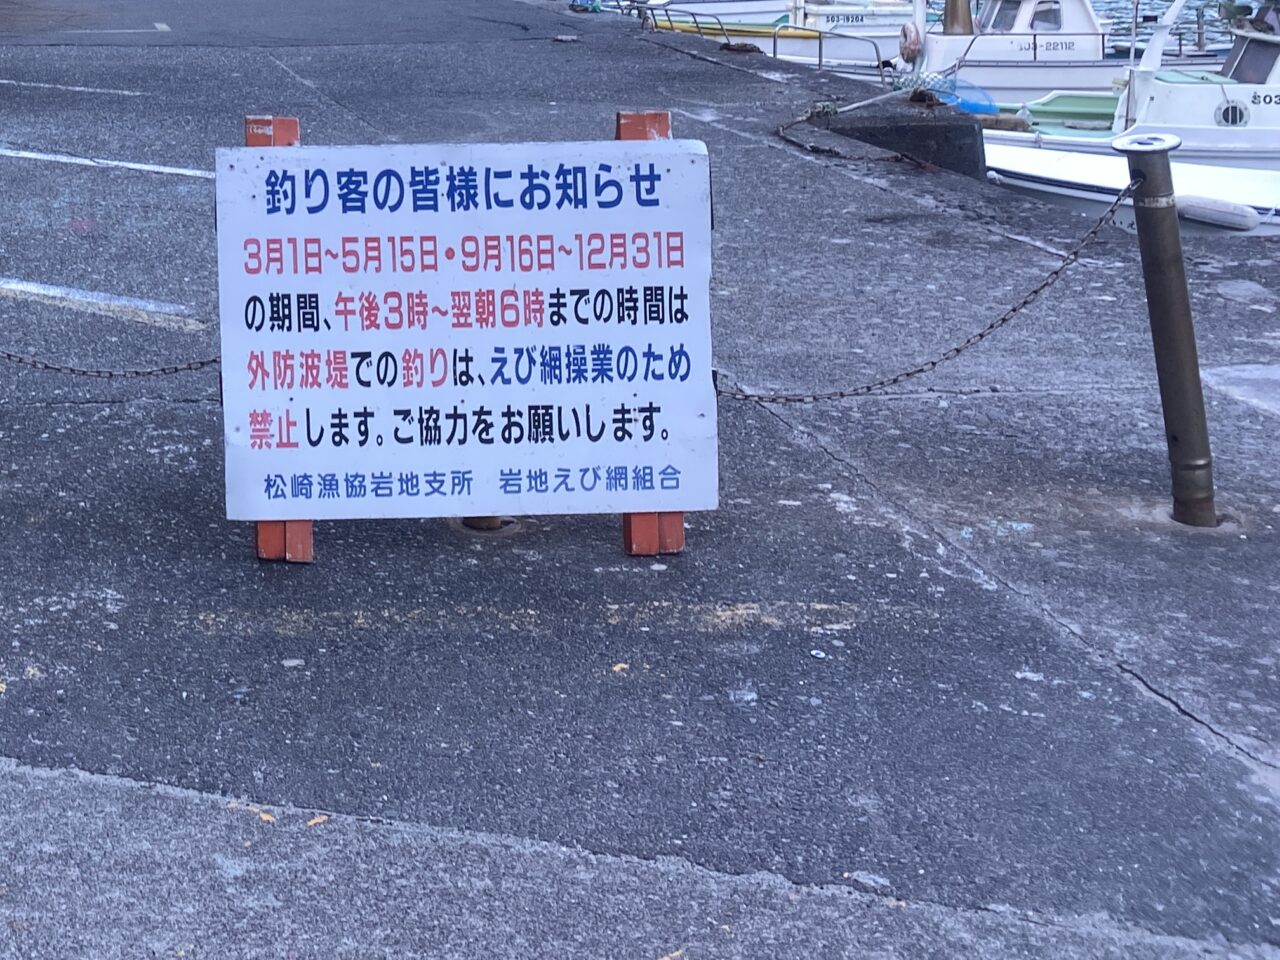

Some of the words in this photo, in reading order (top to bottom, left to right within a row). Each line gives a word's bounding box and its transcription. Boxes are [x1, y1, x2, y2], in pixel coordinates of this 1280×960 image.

[264, 162, 662, 215] 釣り客の皆様にお知らせ
[498, 464, 682, 496] 岩地えび網組合
